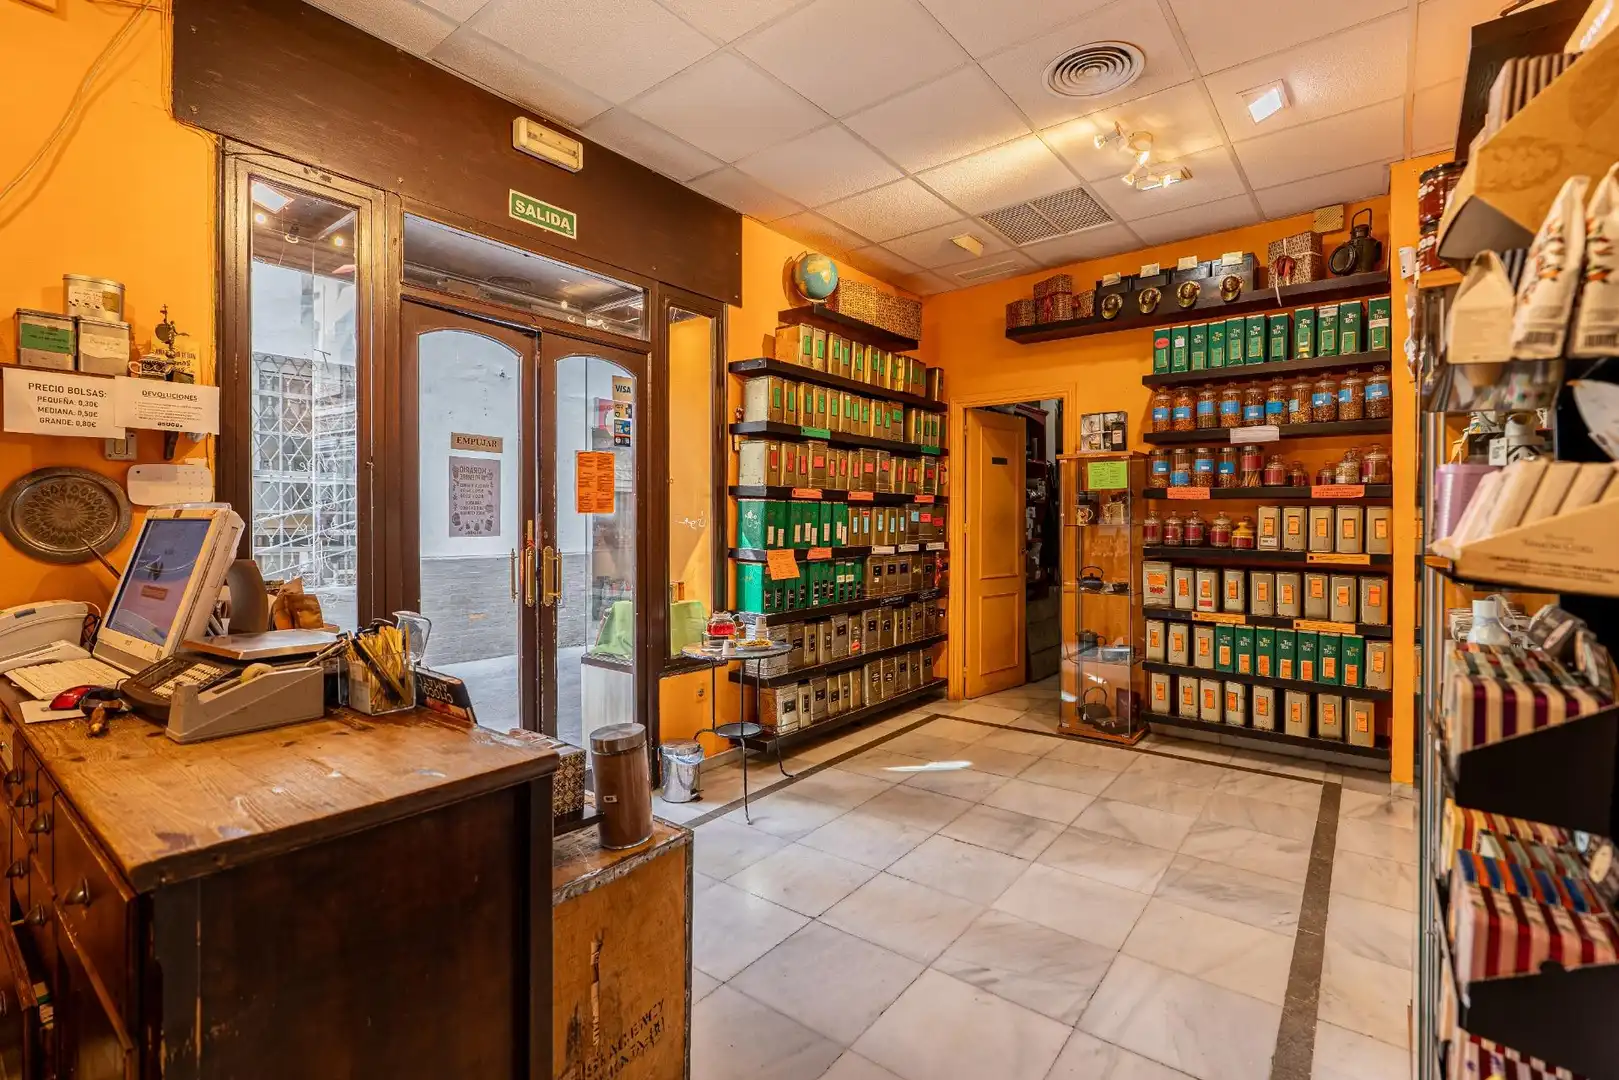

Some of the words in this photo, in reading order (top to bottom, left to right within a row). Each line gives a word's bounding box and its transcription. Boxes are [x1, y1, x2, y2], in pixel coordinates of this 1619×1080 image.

[515, 199, 572, 231] SALIDA
[28, 382, 65, 394] PRECIO
[67, 386, 107, 399] BOLSAS:
[615, 384, 632, 394] VISA
[142, 390, 198, 401] DEVOLUCIONES
[78, 400, 99, 409] 0,30€
[77, 410, 98, 418] 0,50€
[39, 416, 74, 426] GRANDE:
[75, 420, 97, 429] 0,80€
[456, 436, 498, 448] EMPUJAR
